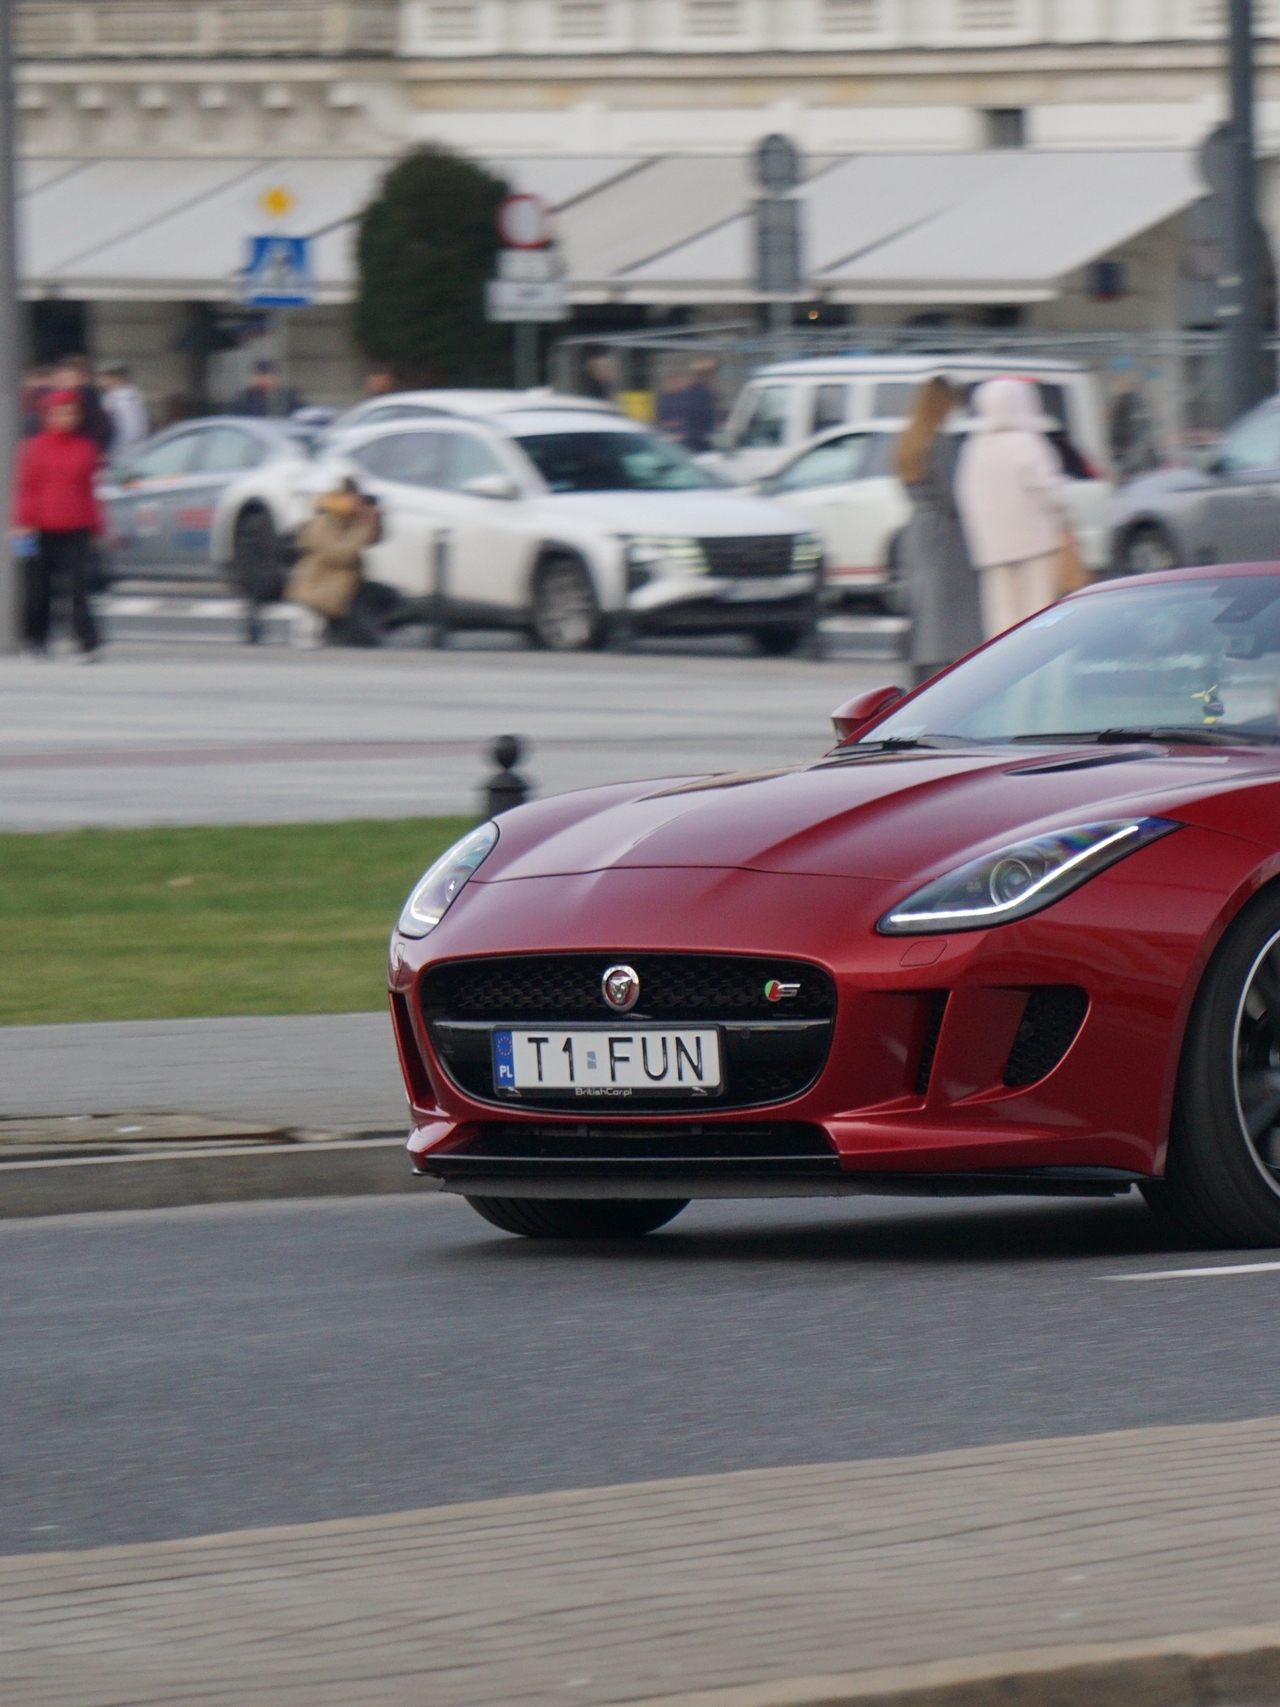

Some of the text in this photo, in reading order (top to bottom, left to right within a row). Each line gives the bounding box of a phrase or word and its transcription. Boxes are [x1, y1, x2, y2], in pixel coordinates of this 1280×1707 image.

[527, 1036, 704, 1082] T1 FUN
[499, 1065, 513, 1078] PL
[575, 1087, 632, 1097] BritishCar.pl
